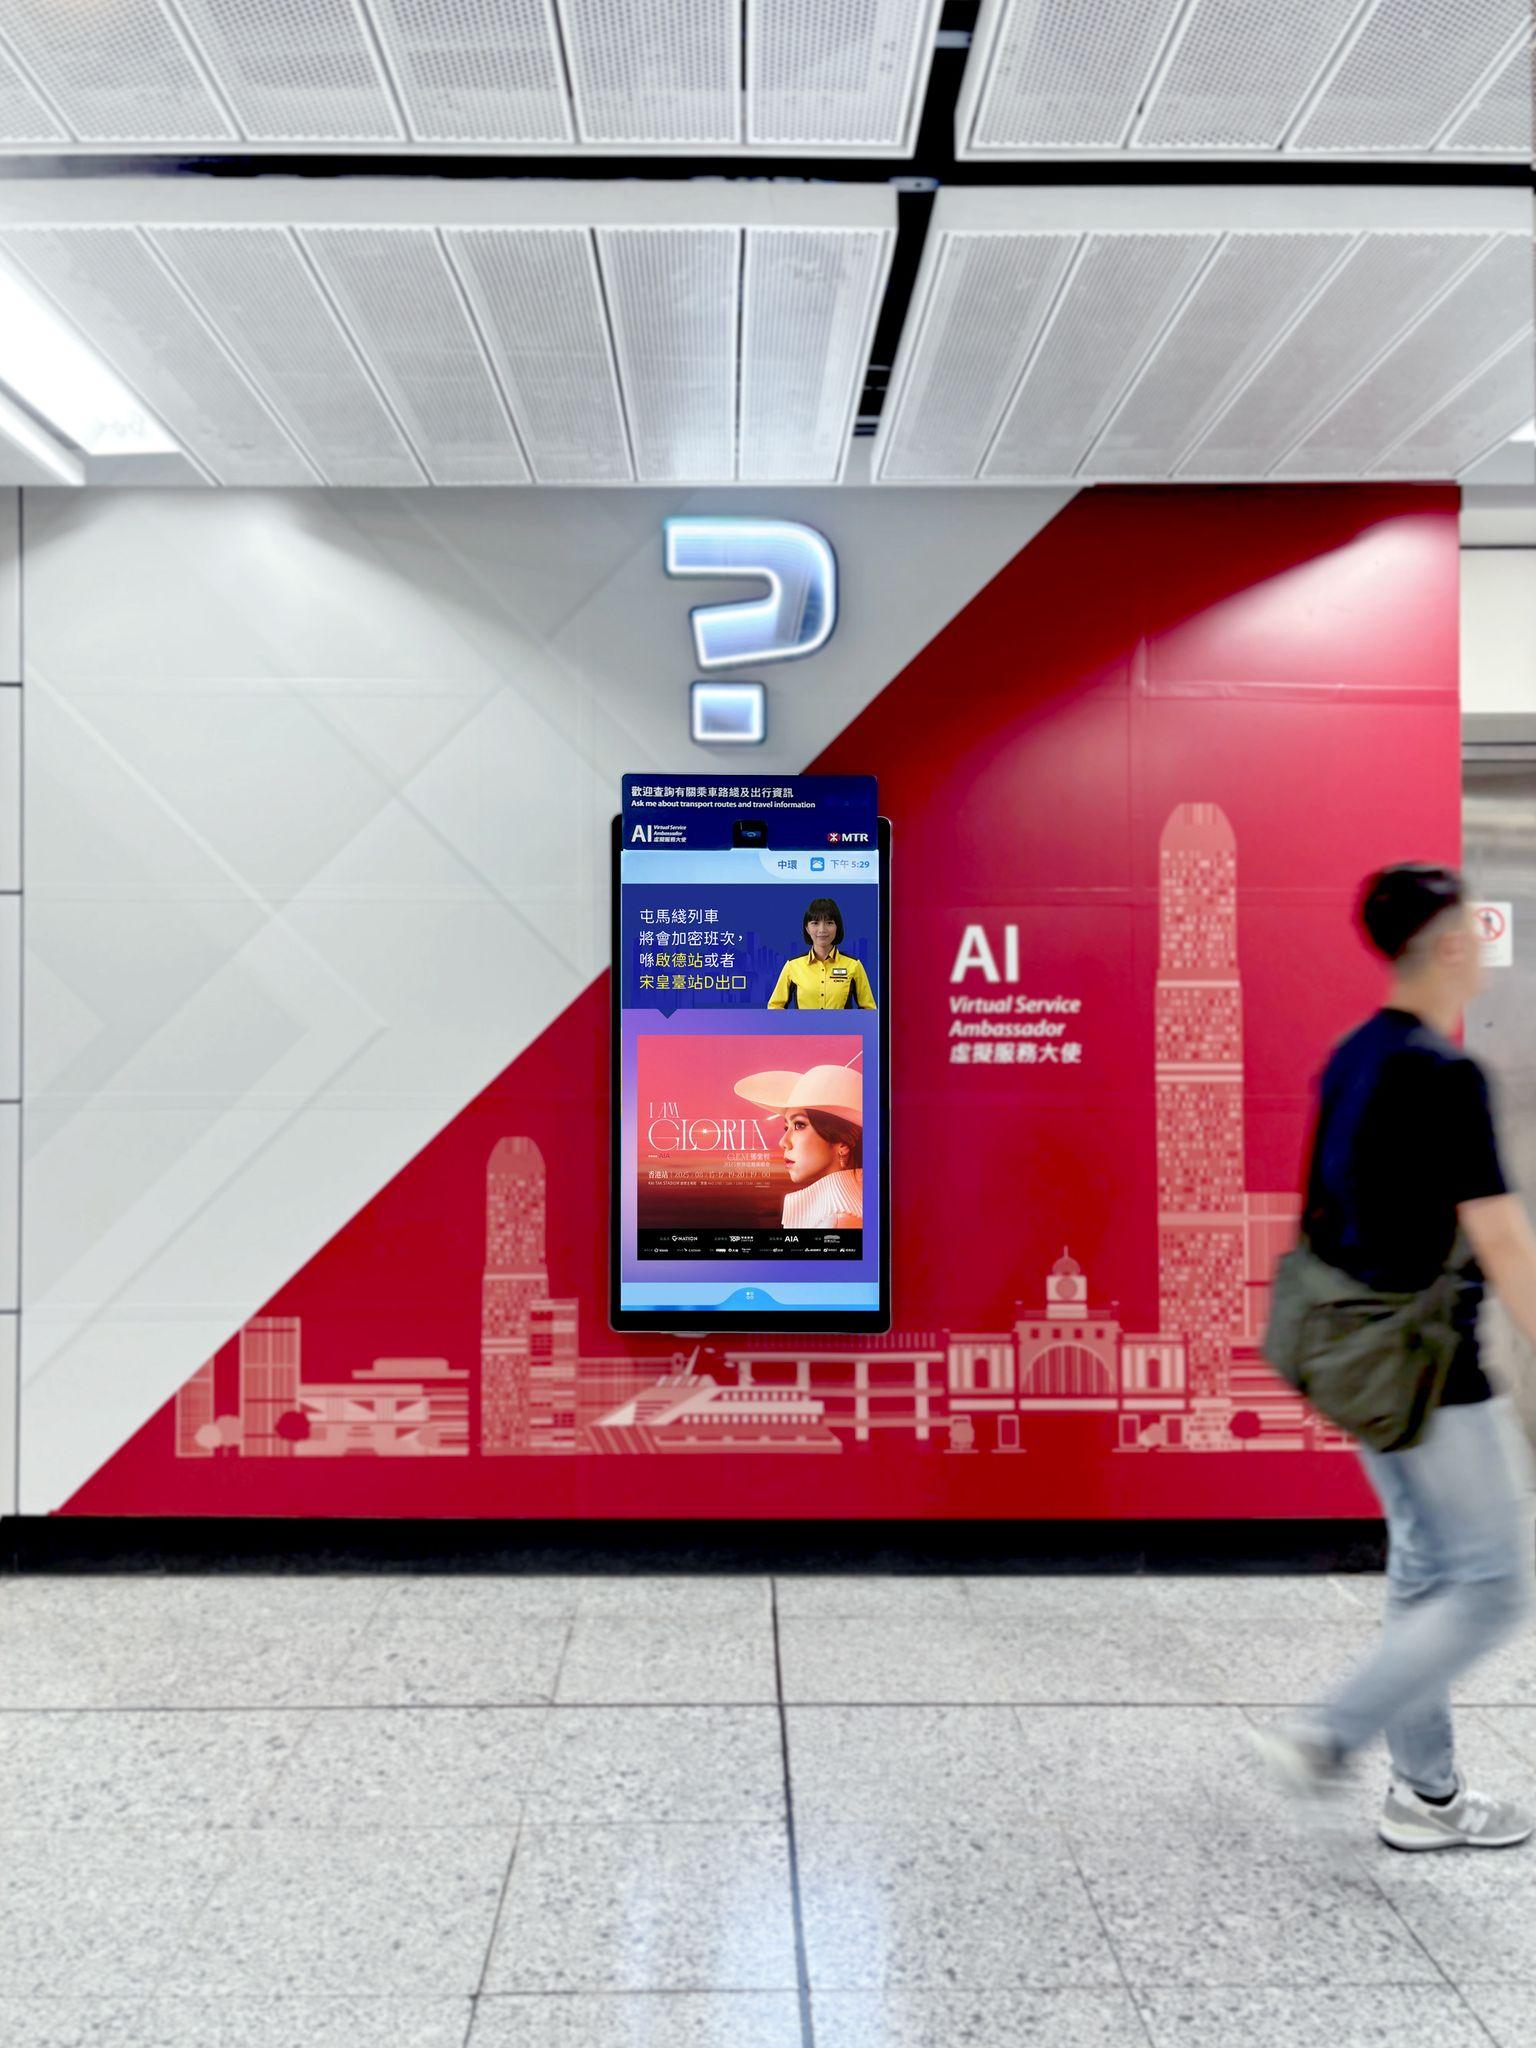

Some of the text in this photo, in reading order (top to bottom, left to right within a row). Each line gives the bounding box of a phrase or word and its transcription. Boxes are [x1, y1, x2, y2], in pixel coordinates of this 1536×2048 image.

[631, 786, 794, 798] 歡迎查詢有關乘車路綫及出行資訊
[680, 801, 713, 809] transport
[631, 825, 653, 843] AI
[841, 833, 869, 842] MTR
[777, 859, 798, 870] 中環
[830, 859, 870, 869] 下午 5:29
[639, 908, 719, 924] 屯馬綫列車
[950, 924, 1019, 983] AI
[949, 995, 1082, 1014] Virtual Service
[948, 1019, 1066, 1038] Ambassador
[657, 1102, 680, 1118] AM
[648, 1118, 769, 1151] GLORIA
[784, 1235, 799, 1243] AIA
